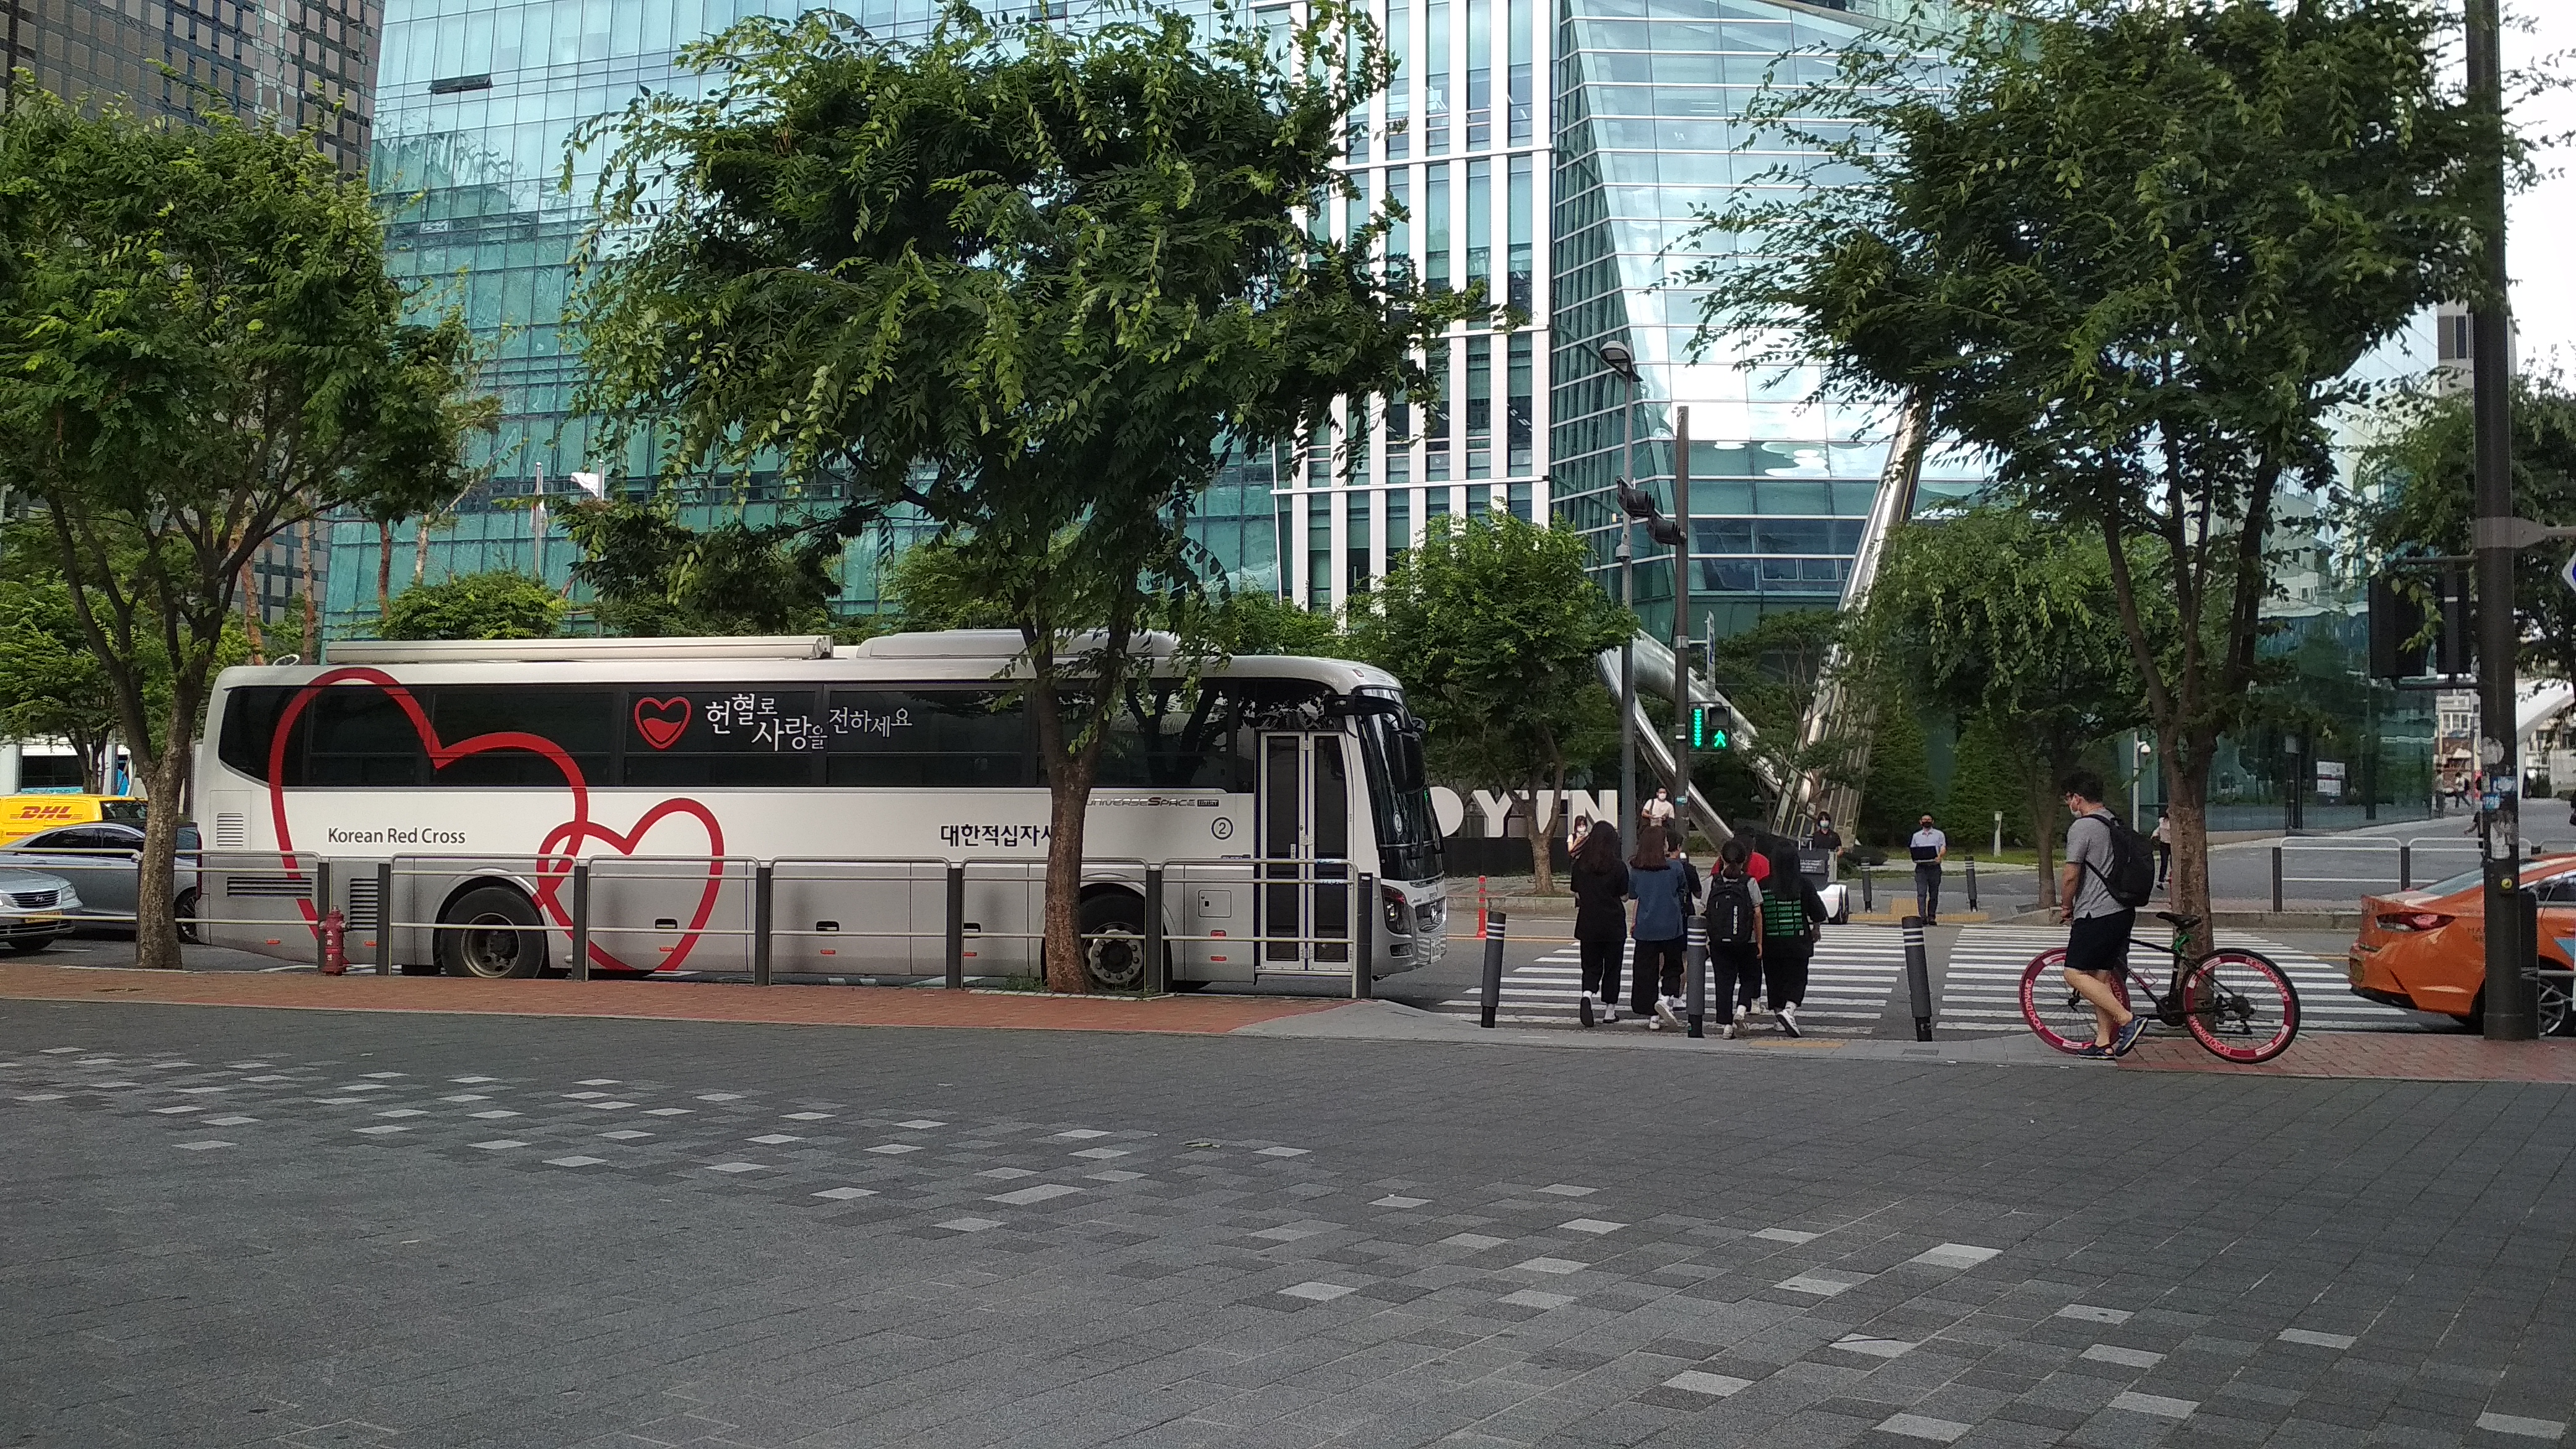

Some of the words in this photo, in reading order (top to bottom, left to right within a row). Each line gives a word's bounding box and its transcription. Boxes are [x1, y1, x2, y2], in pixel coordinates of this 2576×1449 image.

[705, 693, 778, 734] 헌혈로
[829, 707, 913, 738] 전하세요
[751, 715, 828, 752] 사랑을
[19, 806, 72, 819] DHL
[328, 827, 383, 843] Korean
[387, 827, 417, 843] Red
[422, 828, 466, 843] Cross
[2209, 1039, 2232, 1055] ROAD
